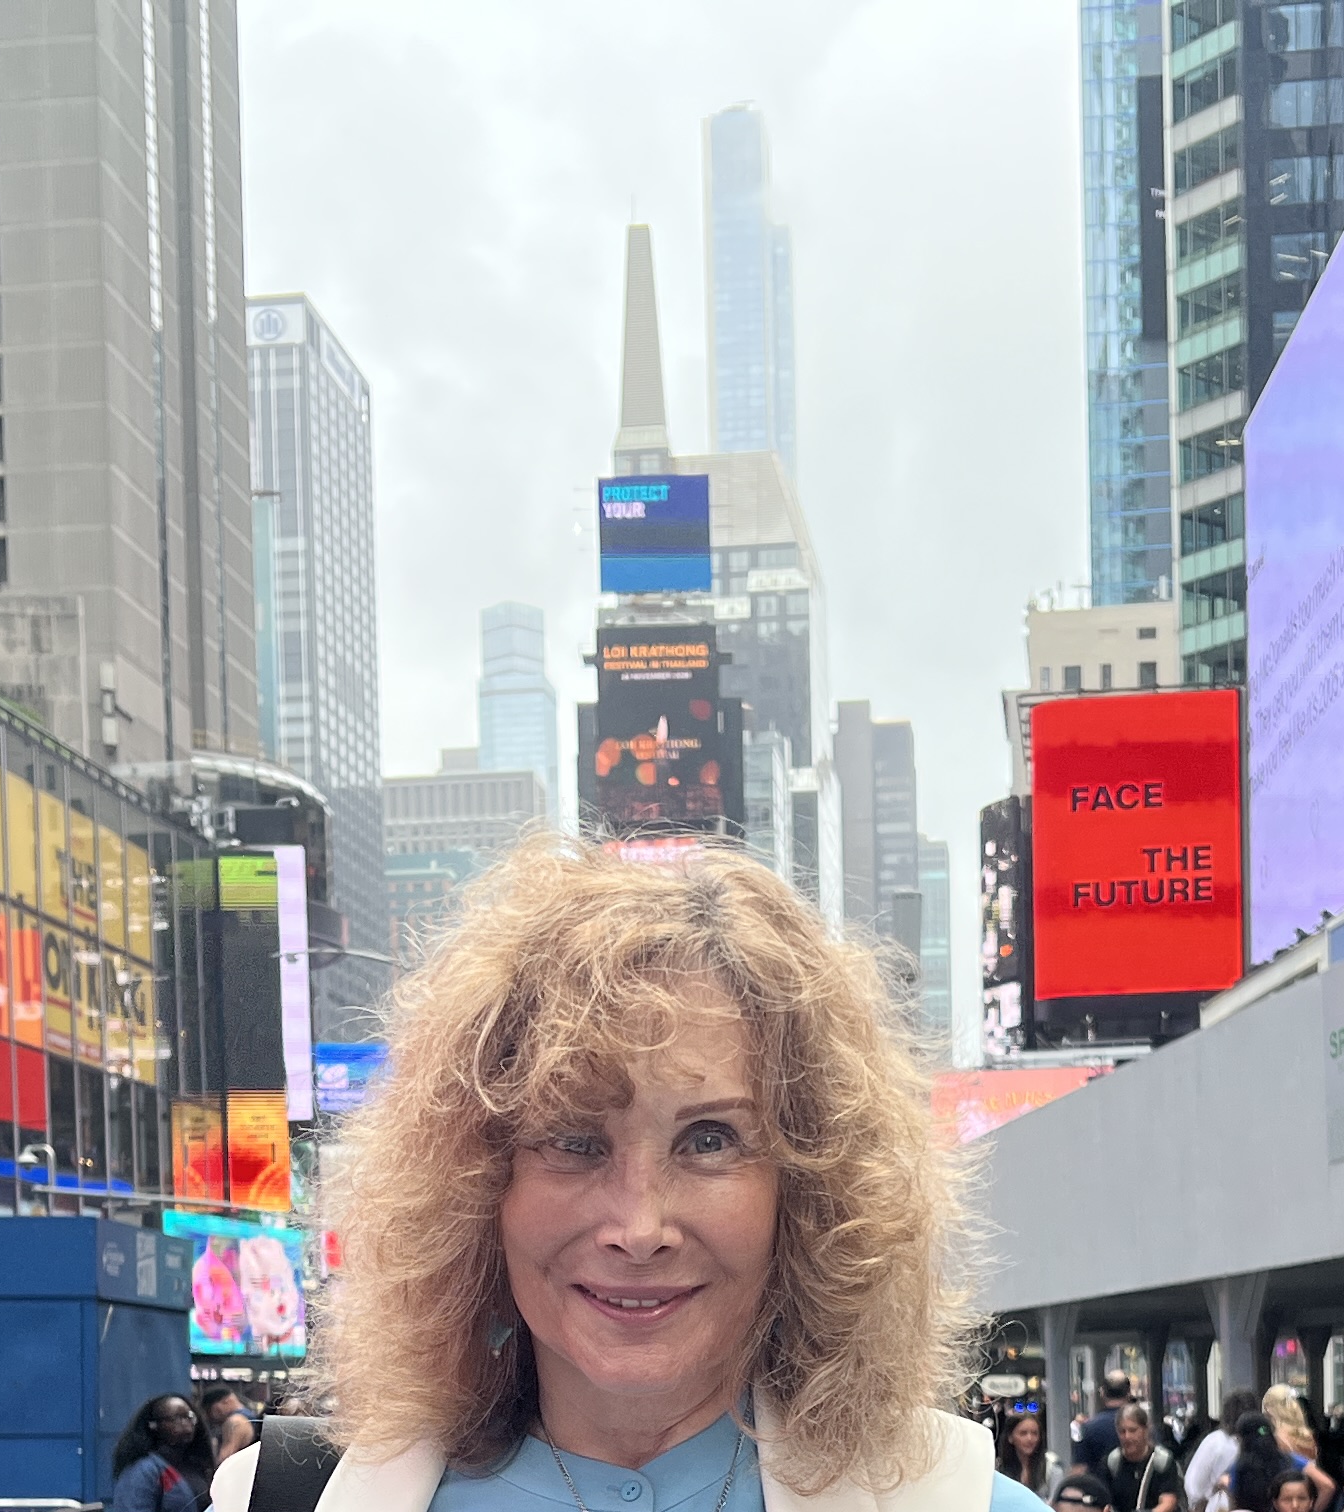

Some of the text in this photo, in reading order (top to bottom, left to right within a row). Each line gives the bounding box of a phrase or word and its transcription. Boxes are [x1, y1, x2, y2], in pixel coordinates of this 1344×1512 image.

[602, 485, 670, 503] PROTECT
[602, 502, 646, 518] YOUR
[603, 641, 709, 659] LOI KRATHONG
[1071, 782, 1163, 812] FACE
[1143, 846, 1212, 873] THE
[1073, 877, 1213, 908] FUTURE
